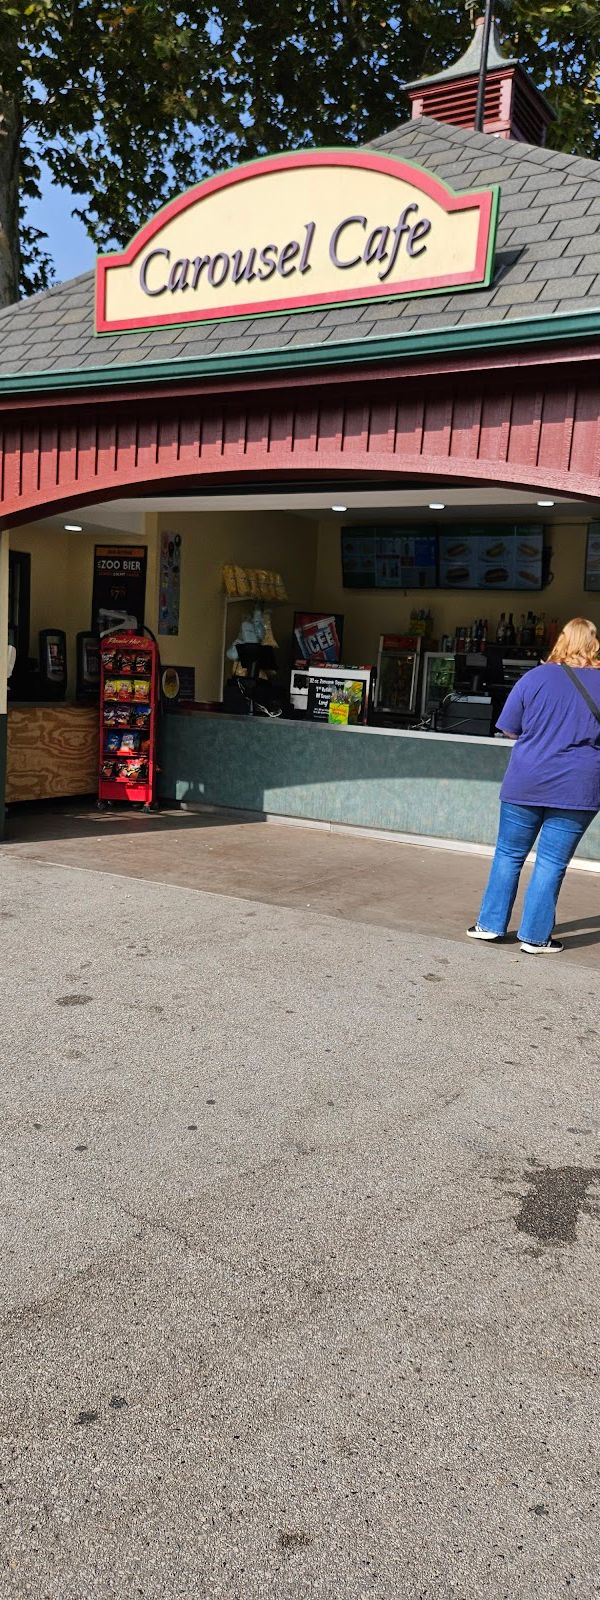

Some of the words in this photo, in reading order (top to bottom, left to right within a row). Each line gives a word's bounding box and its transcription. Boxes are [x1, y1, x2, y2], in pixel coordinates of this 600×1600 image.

[139, 221, 316, 297] Carousel
[329, 203, 432, 280] Cafe
[101, 560, 120, 570] ZOO
[122, 560, 141, 571] BIER
